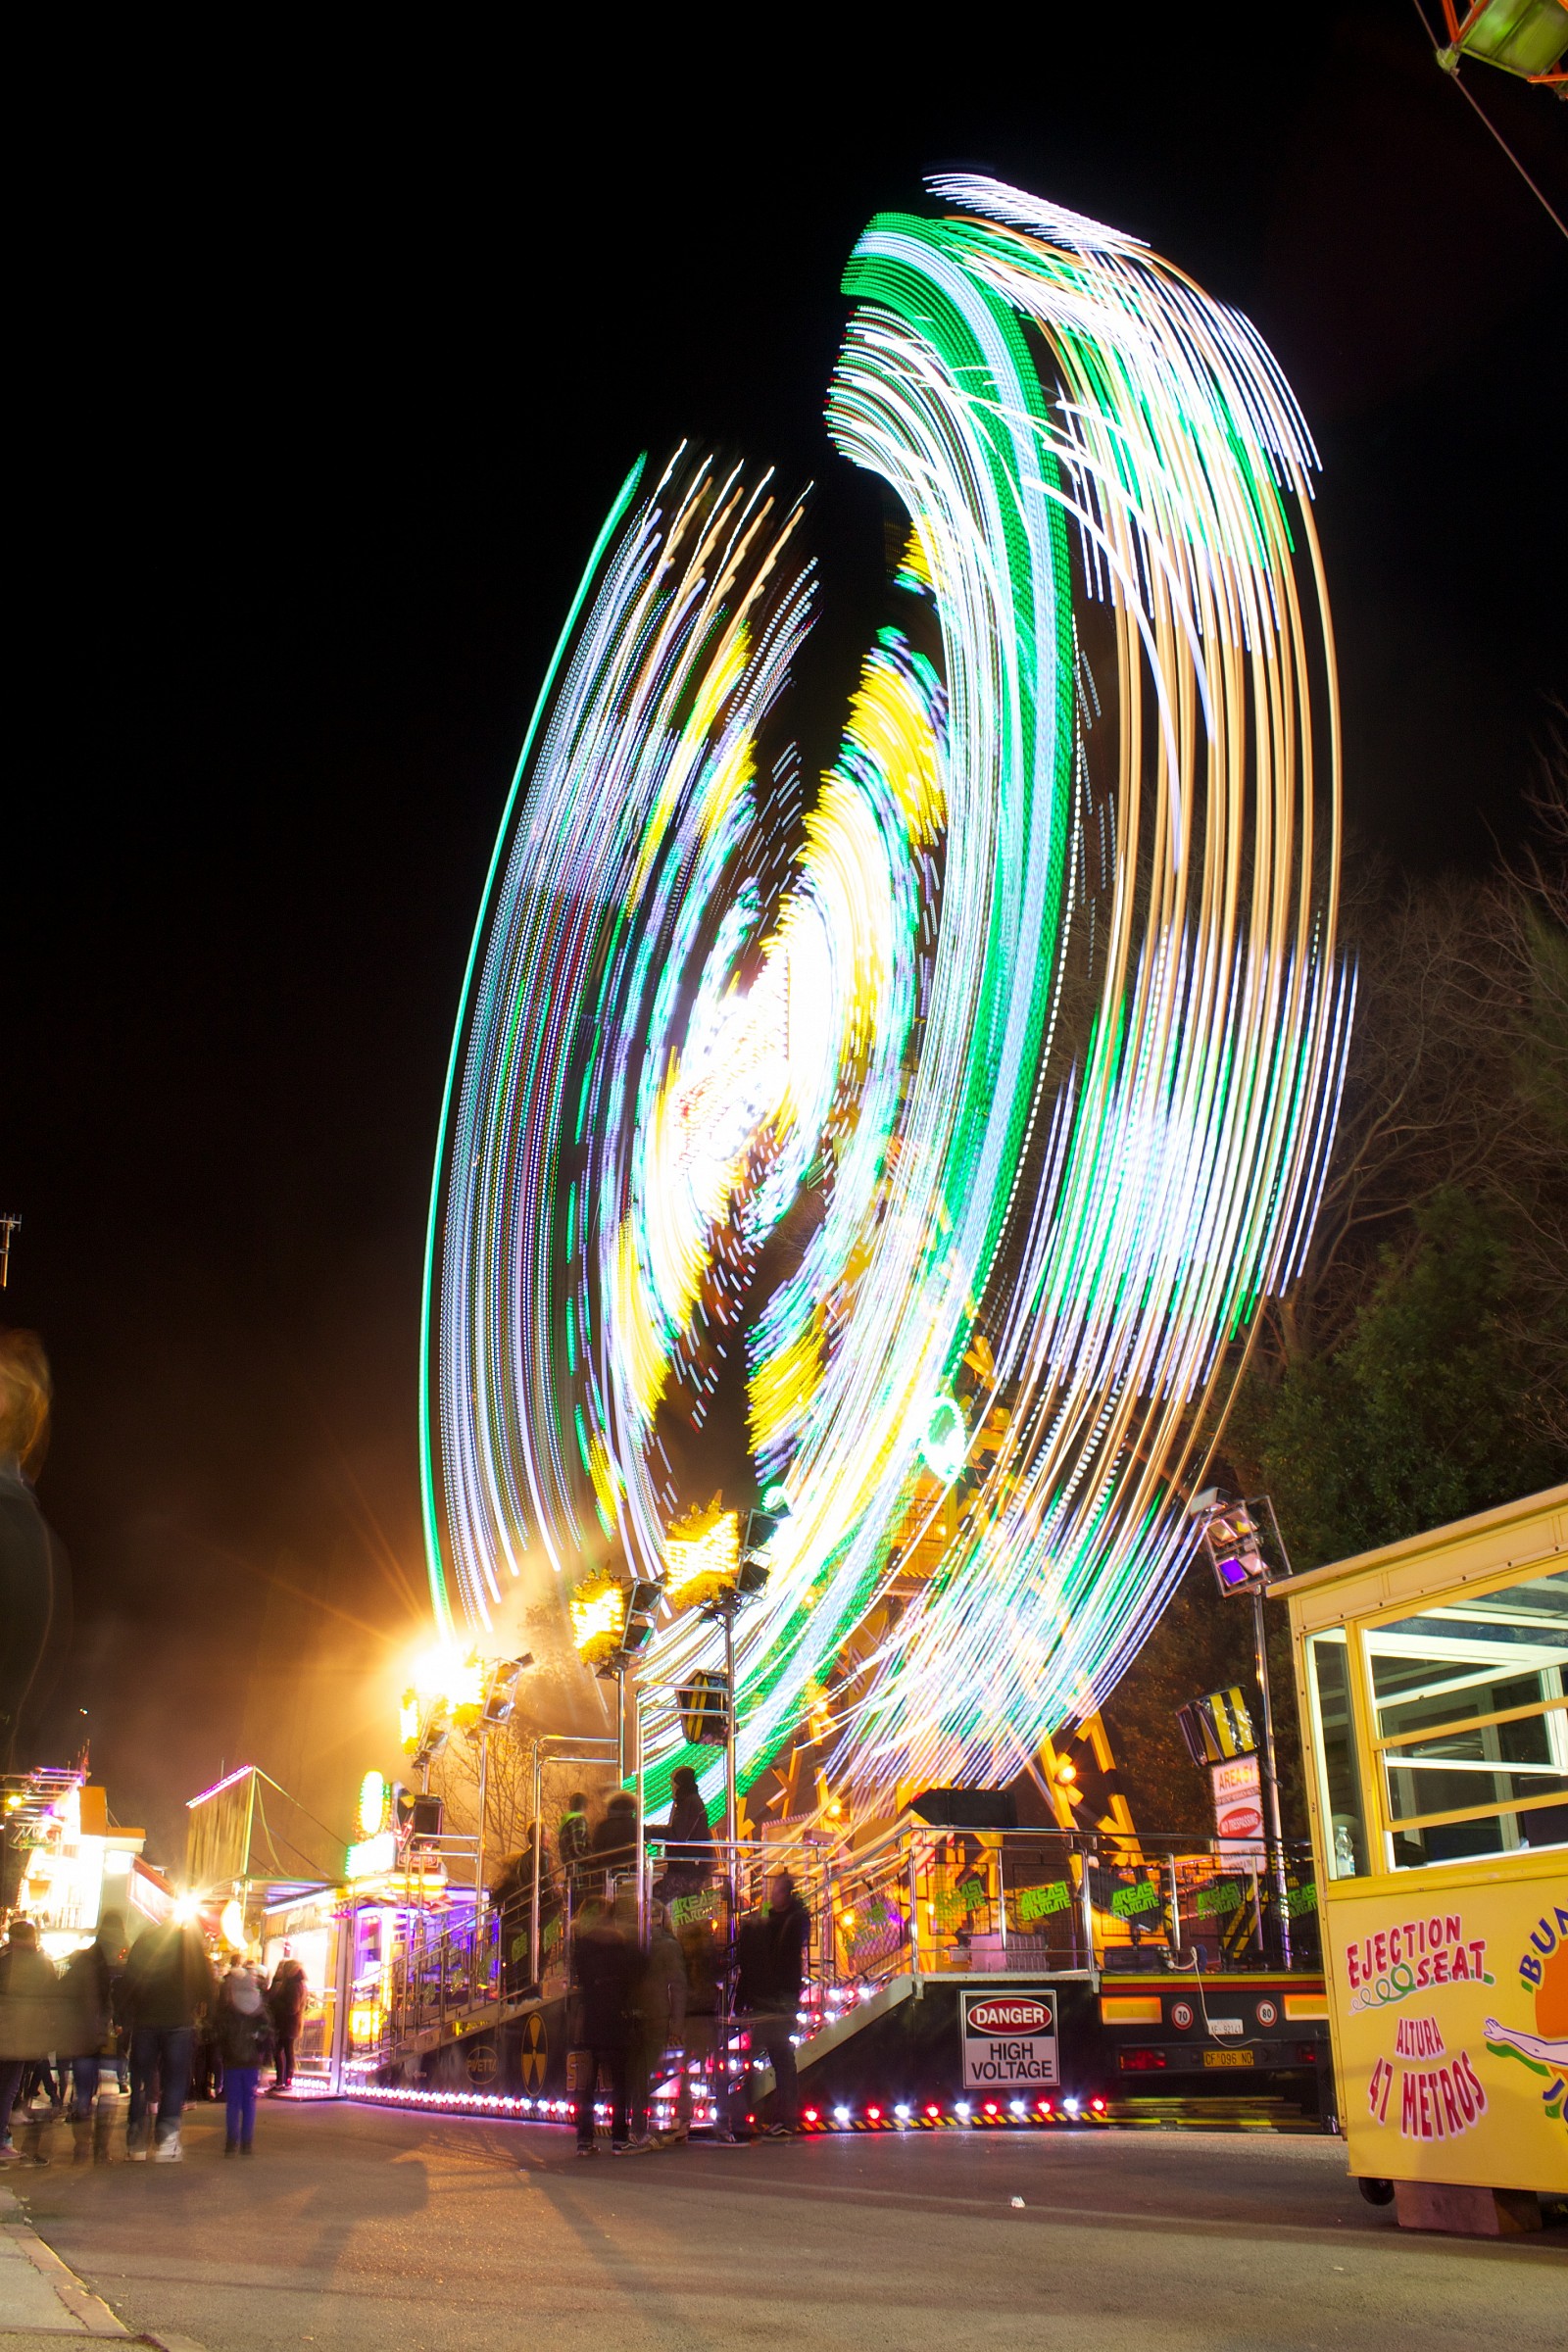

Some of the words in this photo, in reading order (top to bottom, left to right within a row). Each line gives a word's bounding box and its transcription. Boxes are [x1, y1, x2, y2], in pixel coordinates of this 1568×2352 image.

[1219, 1766, 1242, 1791] AREA
[1243, 1763, 1254, 1785] 51
[1022, 1897, 1072, 1921] STARGATE
[1113, 1896, 1160, 1919] STARGATE
[1347, 1914, 1462, 1991] EJECTION
[1416, 1938, 1487, 1987] SEAT
[976, 2007, 1045, 2025] DANGER
[1178, 2010, 1188, 2021] 70
[1262, 2008, 1272, 2019] 80
[1396, 2017, 1446, 2057] ALTURA
[990, 2041, 1034, 2060] HIGH
[1205, 2053, 1216, 2065] CF
[1221, 2053, 1237, 2065] 096
[971, 2060, 1054, 2080] VOLTAGE
[1368, 2057, 1394, 2125] 47
[1400, 2051, 1487, 2139] METROS
